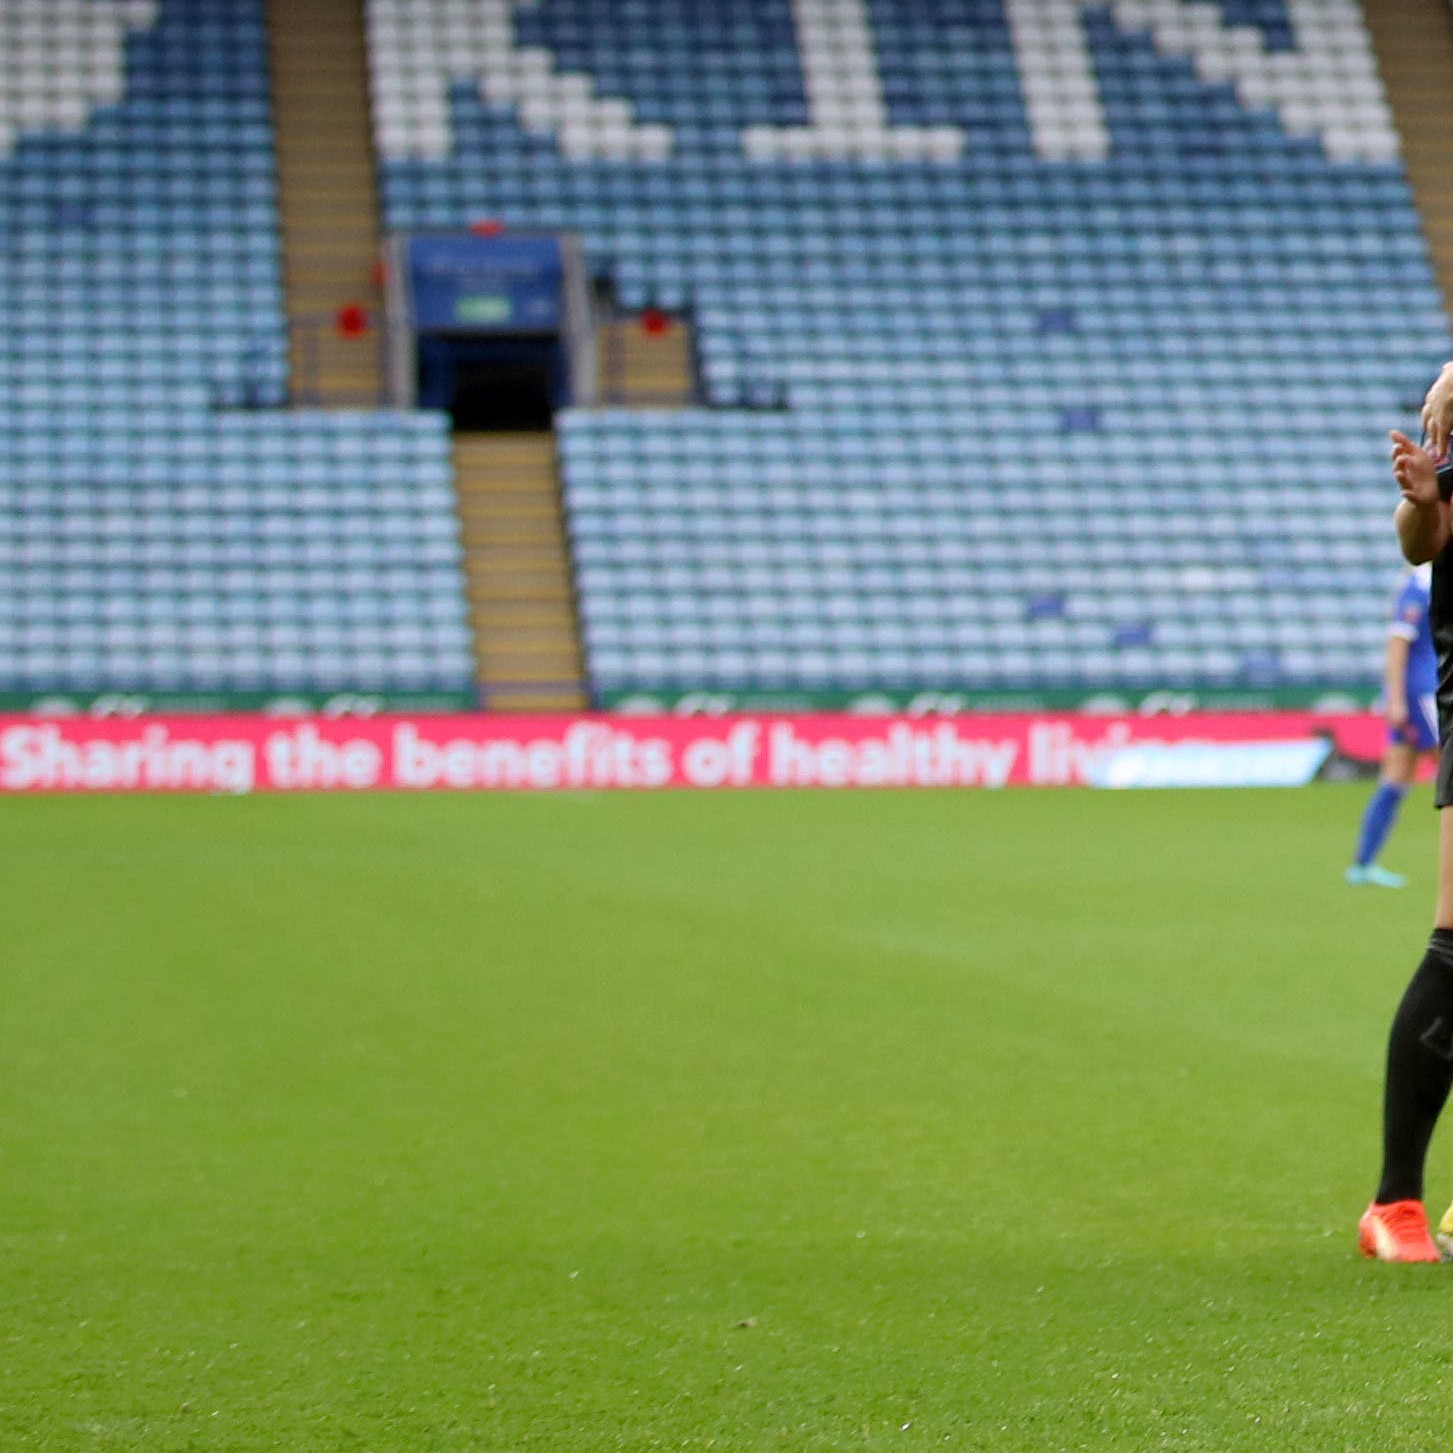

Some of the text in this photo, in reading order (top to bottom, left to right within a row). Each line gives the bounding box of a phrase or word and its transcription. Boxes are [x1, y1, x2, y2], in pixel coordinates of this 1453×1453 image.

[1, 723, 257, 793] Sharing
[265, 723, 382, 789] the
[397, 721, 672, 788] benefits
[682, 720, 760, 788] of
[768, 720, 1017, 788] healthy
